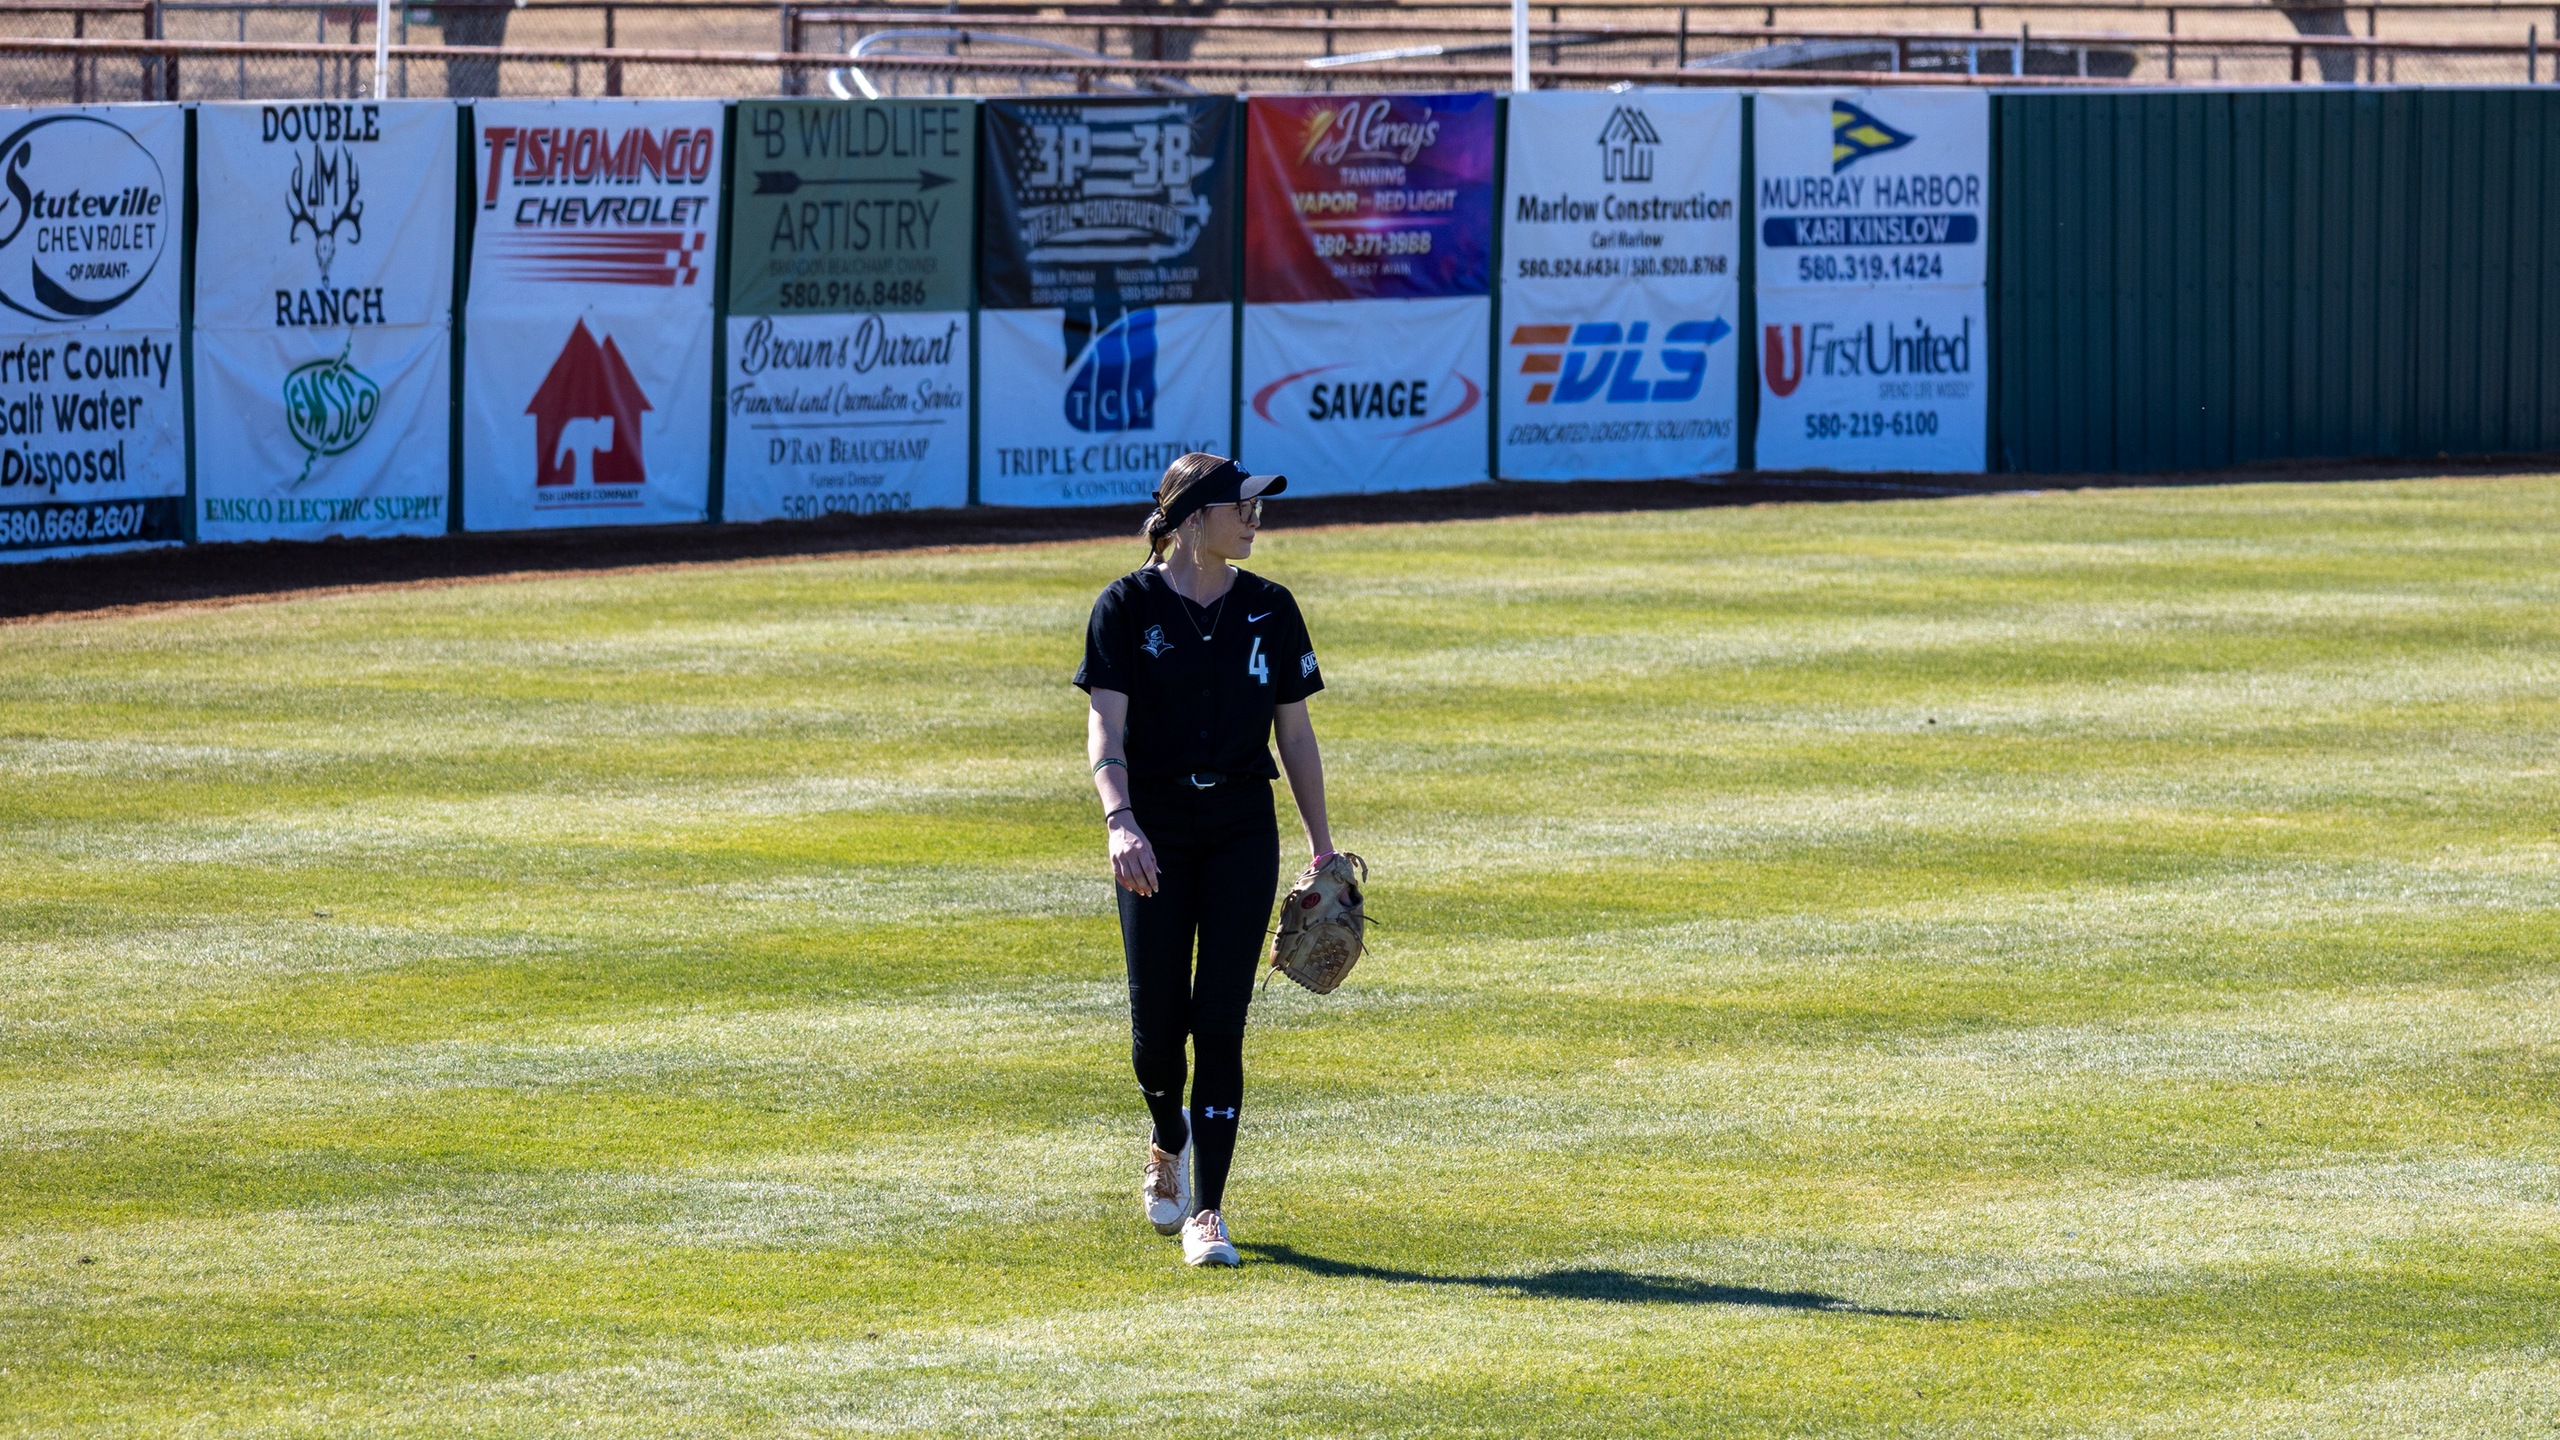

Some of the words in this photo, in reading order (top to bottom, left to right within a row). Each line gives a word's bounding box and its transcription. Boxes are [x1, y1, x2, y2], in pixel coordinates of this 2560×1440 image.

[262, 105, 380, 142] DOUBLE
[799, 106, 960, 158] WILDLIFE
[484, 127, 714, 209] TISHOMINGO
[1031, 125, 1092, 188] 3P
[1132, 124, 1192, 186] 3B
[1340, 166, 1406, 186] TANNING
[1762, 176, 1863, 208] MURRAY
[1874, 175, 1980, 206] HARBOR
[0, 141, 162, 248] Stuteville
[1291, 190, 1358, 214] VAPOR
[1374, 191, 1405, 211] RED
[1407, 189, 1457, 211] LIGHT
[1517, 195, 1598, 223] Marlow
[1604, 193, 1732, 221] Construction
[514, 197, 709, 228] CHEVROLET
[770, 200, 939, 251] ARTISTRY
[1796, 218, 1844, 244] KARI
[1850, 216, 1950, 243] KINSLOW
[38, 223, 156, 253] CHEVROLET
[1618, 228, 1664, 247] Marlow
[1799, 252, 1942, 281] 580.319.1424
[276, 288, 386, 326] RANCH
[780, 279, 926, 308] 580.916.8486
[740, 314, 849, 376] Brown's
[853, 312, 961, 374] Durant
[1, 342, 54, 383] rter
[64, 336, 172, 389] County
[0, 391, 43, 435] Salt
[52, 389, 143, 433] Water
[291, 369, 375, 446] EMSCO
[731, 382, 799, 416] Funeral
[799, 386, 832, 413] and
[833, 382, 908, 416] Cremation
[1308, 380, 1428, 421] SAVAGE
[1806, 411, 1938, 438] 580-219-6100
[1, 438, 125, 494] Disposal
[828, 436, 930, 465] BEAUCHAMP
[997, 447, 1075, 477] TRIPLE
[1081, 446, 1099, 474] C
[0, 504, 144, 544] 580.668.2601
[204, 498, 272, 524] EMSCO
[277, 497, 370, 523] ELECTRIC
[374, 495, 442, 519] SUPPLY
[1249, 636, 1268, 684] 4
